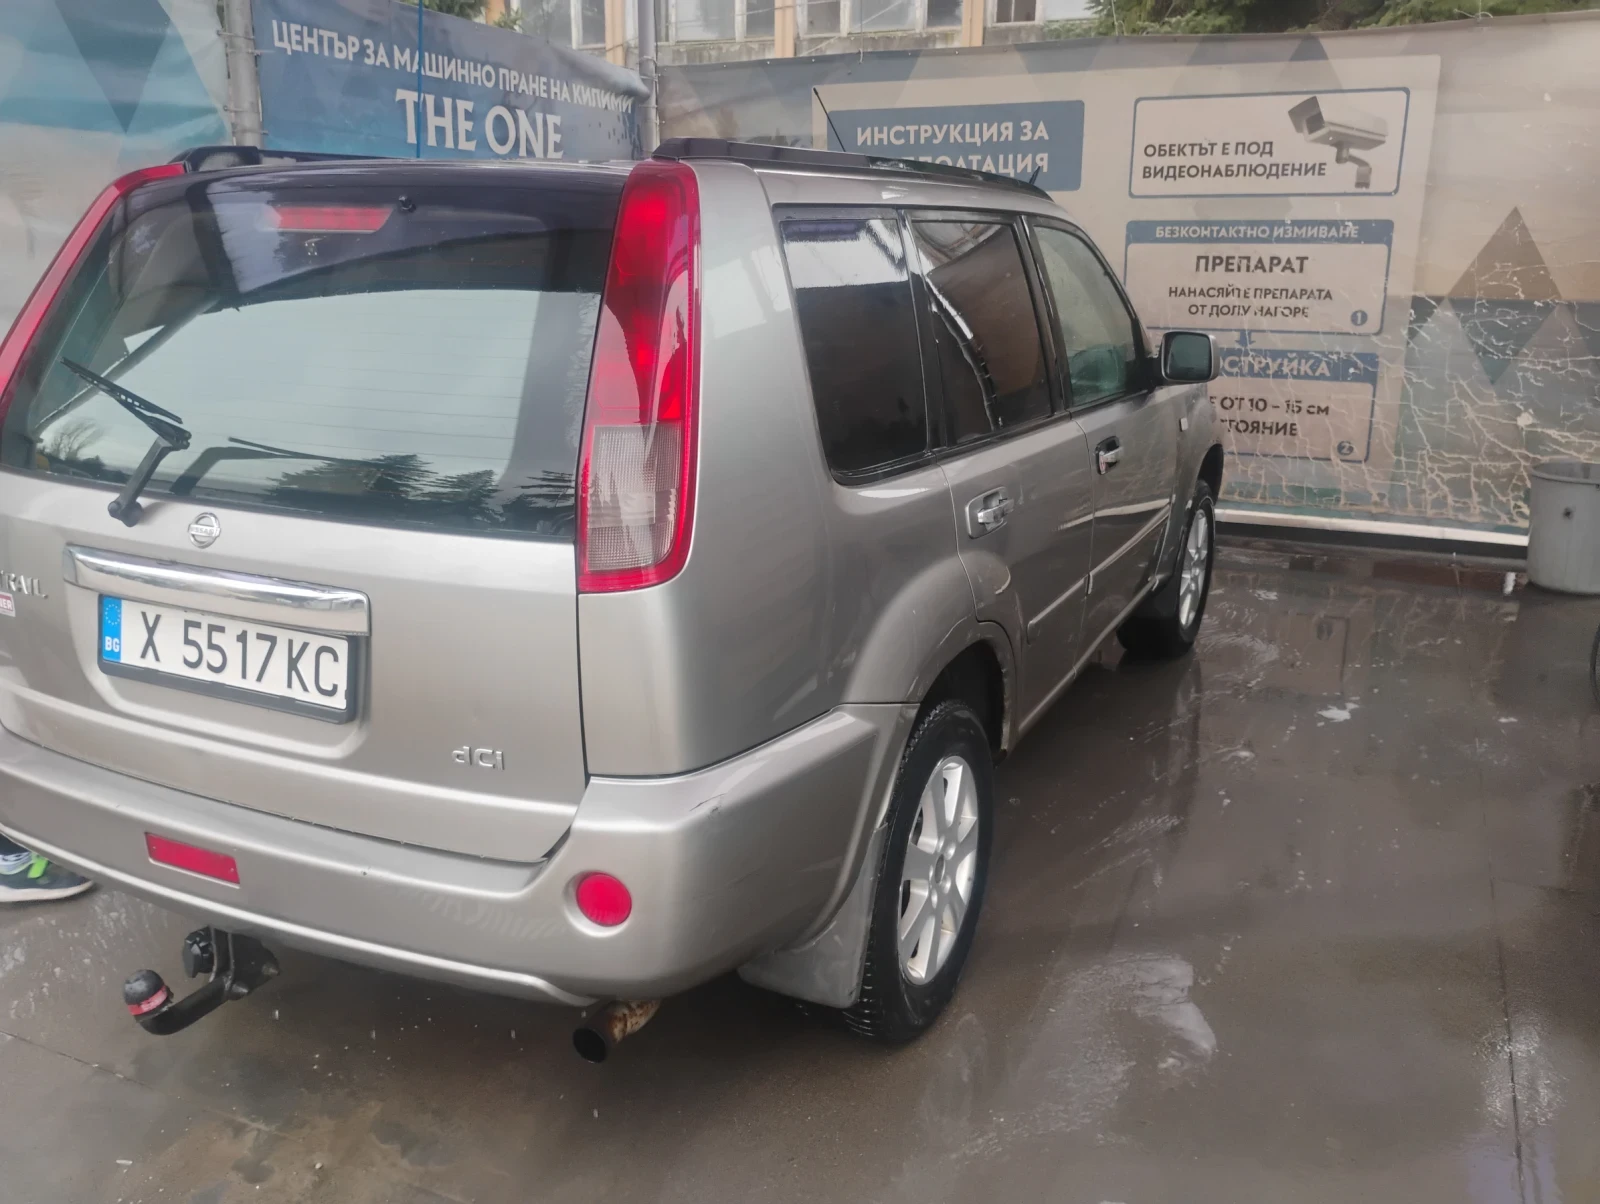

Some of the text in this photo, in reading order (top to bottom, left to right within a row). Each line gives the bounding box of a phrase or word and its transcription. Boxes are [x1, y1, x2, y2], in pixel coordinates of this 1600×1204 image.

[272, 20, 360, 60] ЦЕНТЪР
[364, 37, 391, 69] ЗА
[393, 45, 497, 89] МАШИННО
[499, 68, 548, 100] ПРАНЕ
[550, 79, 571, 103] НА
[396, 89, 564, 159] THE ONE
[856, 120, 1049, 147] ИНСТРУКЦИЯ ЗА
[1143, 141, 1274, 158] ОБЕКТЪТ Е ПОД
[1142, 162, 1327, 181] ВИДЕОНАБЛЮДЕНИЕ
[1155, 225, 1359, 239] БЕЗКОНТАКТНО ИЗМИВАНЕ
[1195, 255, 1309, 274] ПРЕПАРАТ
[1168, 284, 1333, 301] НАНАСЯЙТЕ ПРЕПАРАТА
[1188, 304, 1207, 316] ОТ
[1220, 352, 1331, 377] СТРУЙКА
[1220, 396, 1245, 411] ОТ
[1248, 398, 1267, 412] 10
[1220, 418, 1298, 436] ТОЯНИЕ
[105, 636, 121, 653] BG
